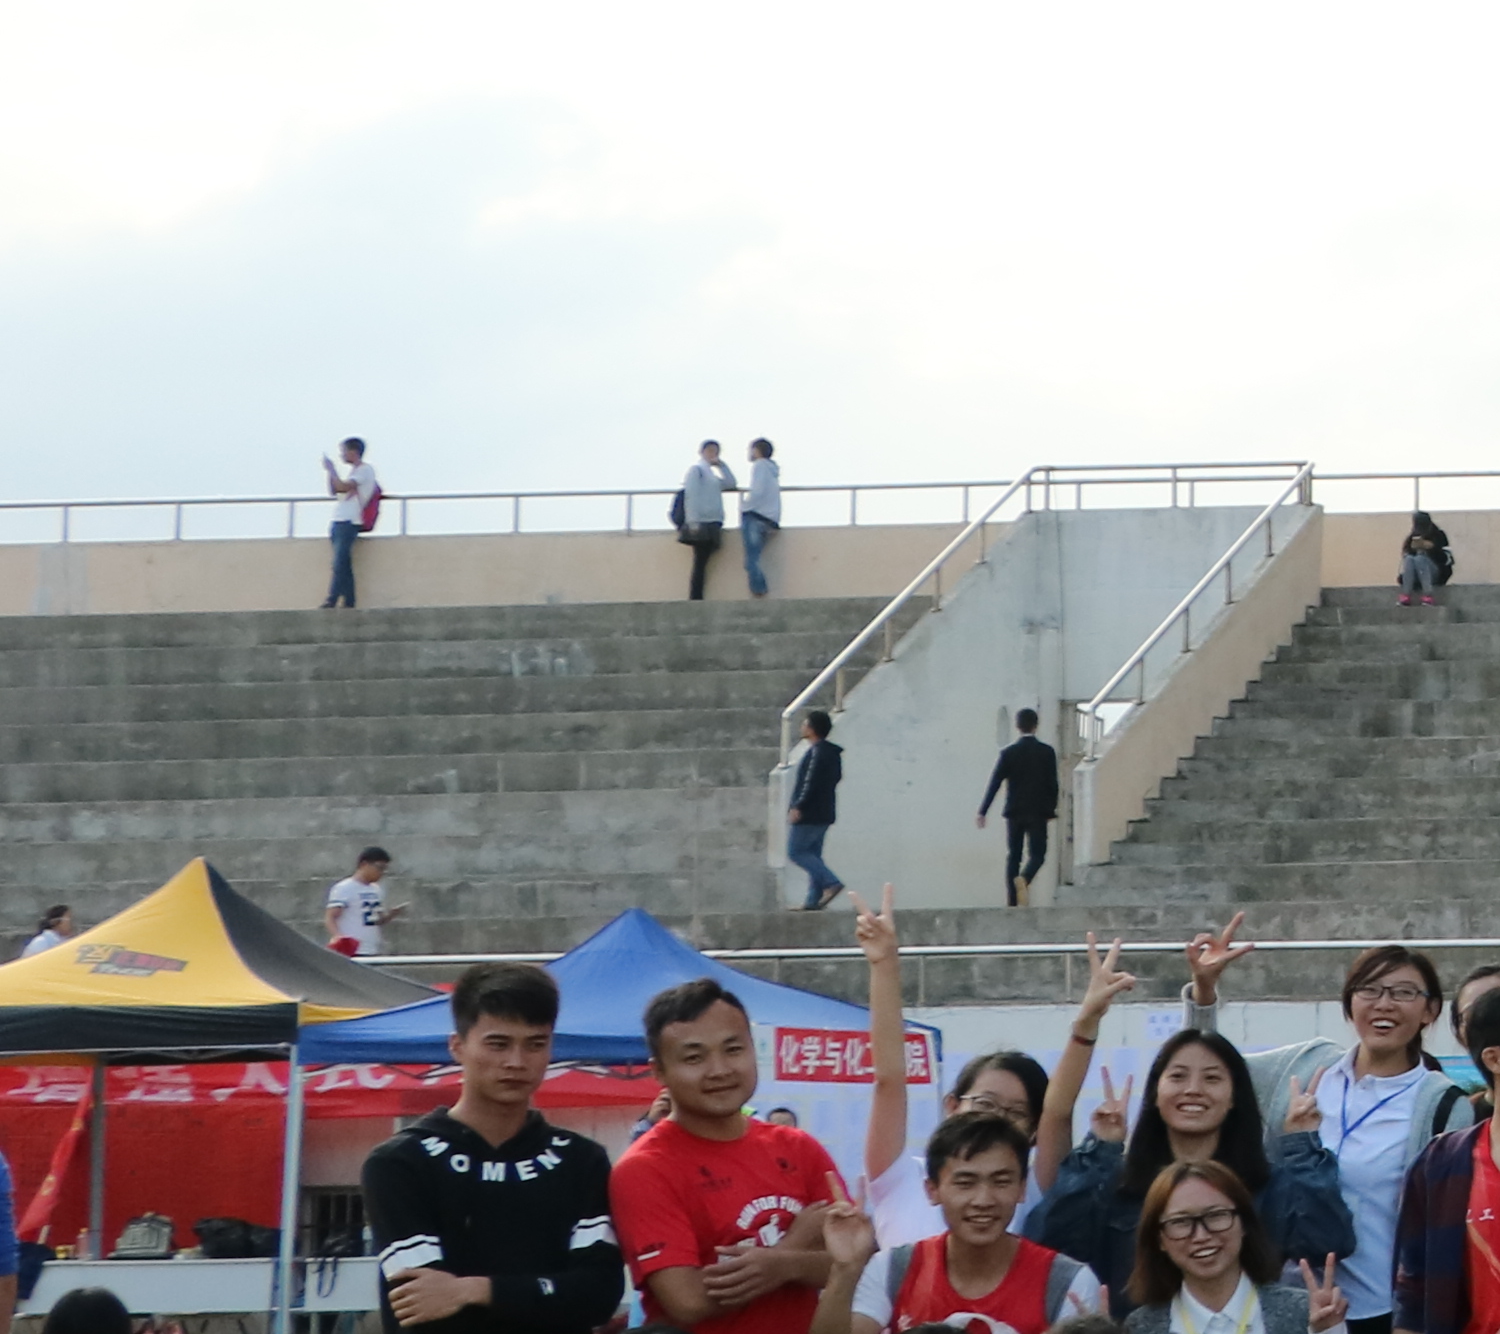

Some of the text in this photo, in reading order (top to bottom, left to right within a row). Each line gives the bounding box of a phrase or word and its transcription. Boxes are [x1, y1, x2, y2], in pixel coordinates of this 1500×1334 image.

[779, 1034, 928, 1076] 化学与化院
